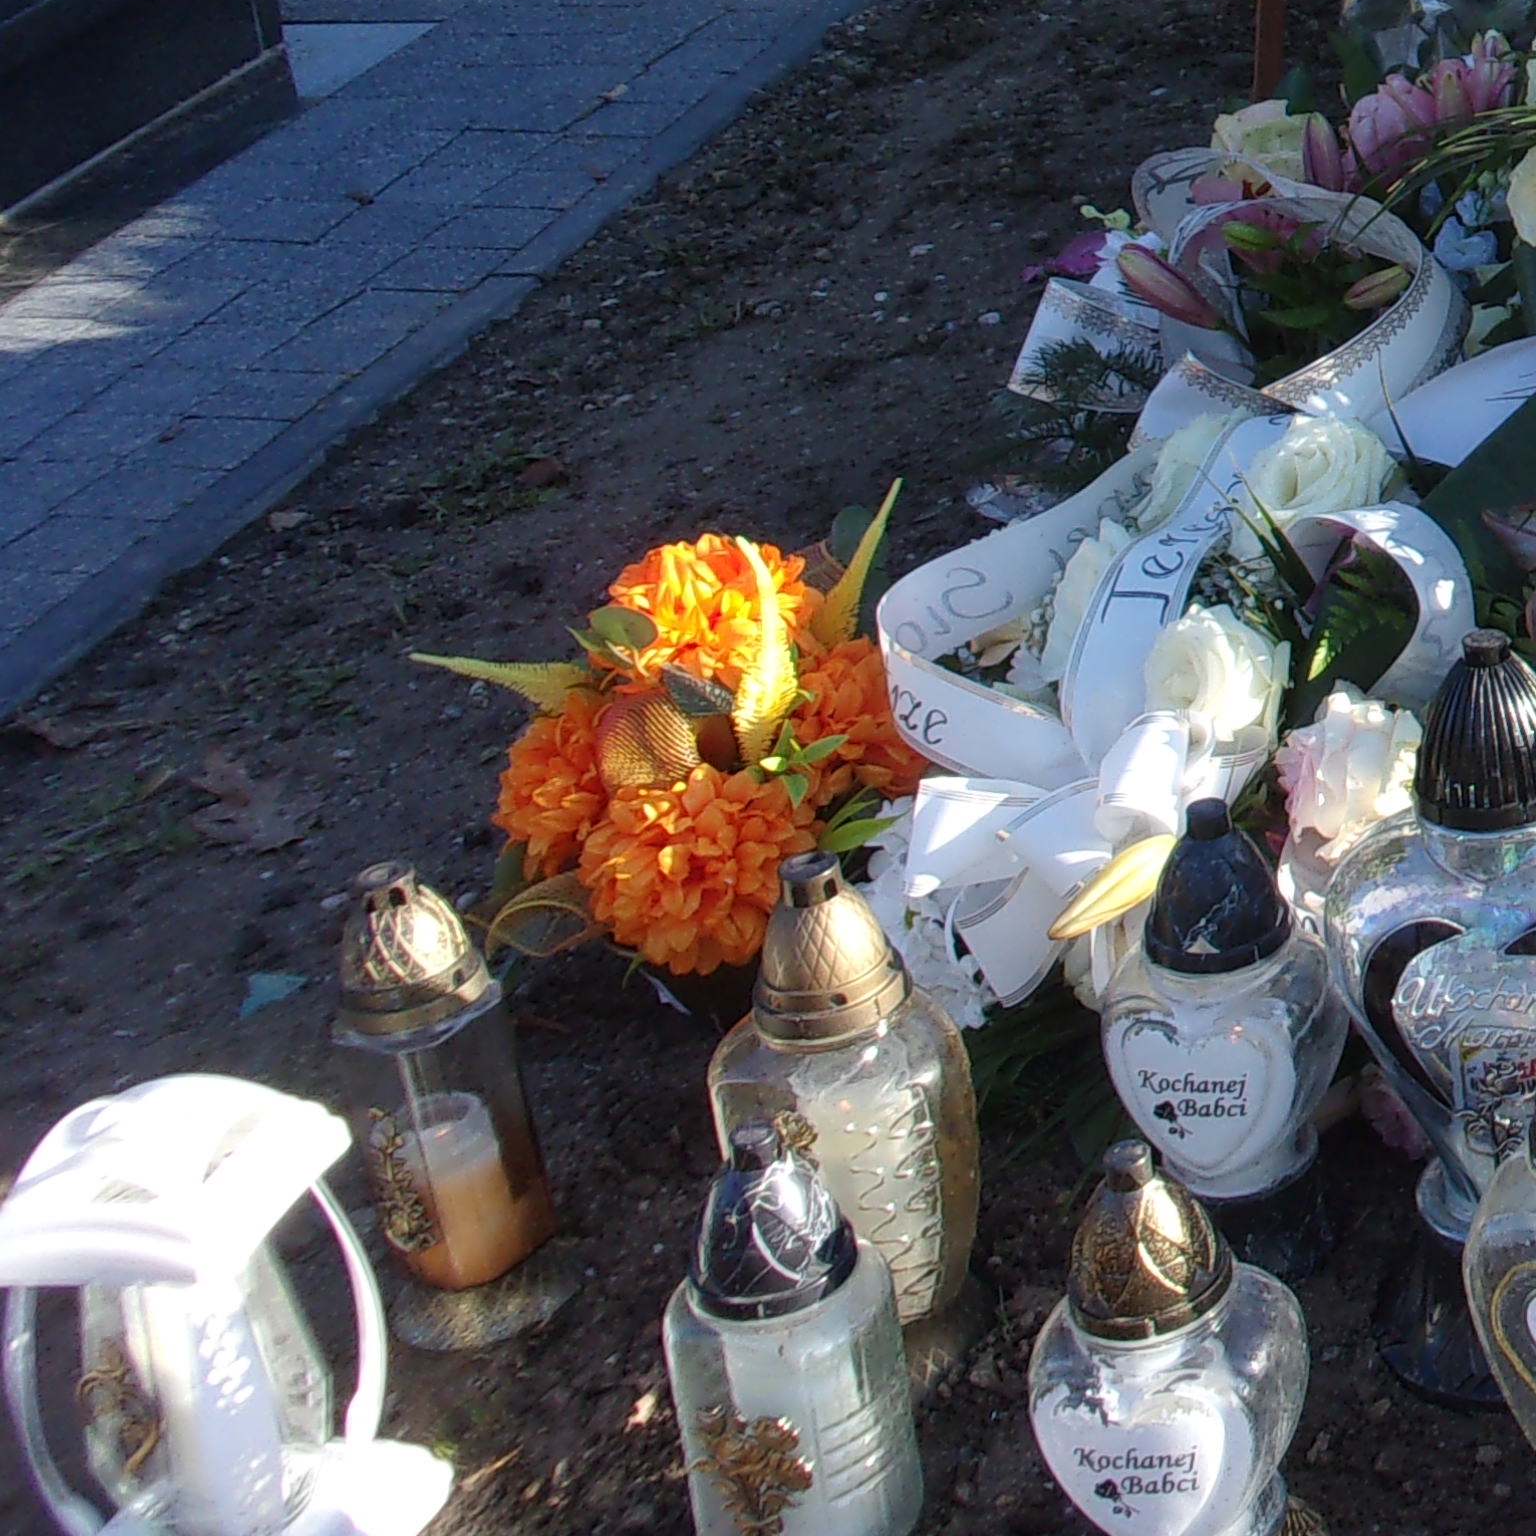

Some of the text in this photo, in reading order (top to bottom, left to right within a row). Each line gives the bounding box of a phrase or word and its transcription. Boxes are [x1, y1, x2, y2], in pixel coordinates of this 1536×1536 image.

[1137, 1068, 1249, 1099] Kochanej
[1176, 1095, 1249, 1120] Babci
[1073, 1444, 1198, 1473] Kochanej
[1119, 1469, 1201, 1495] Babci
